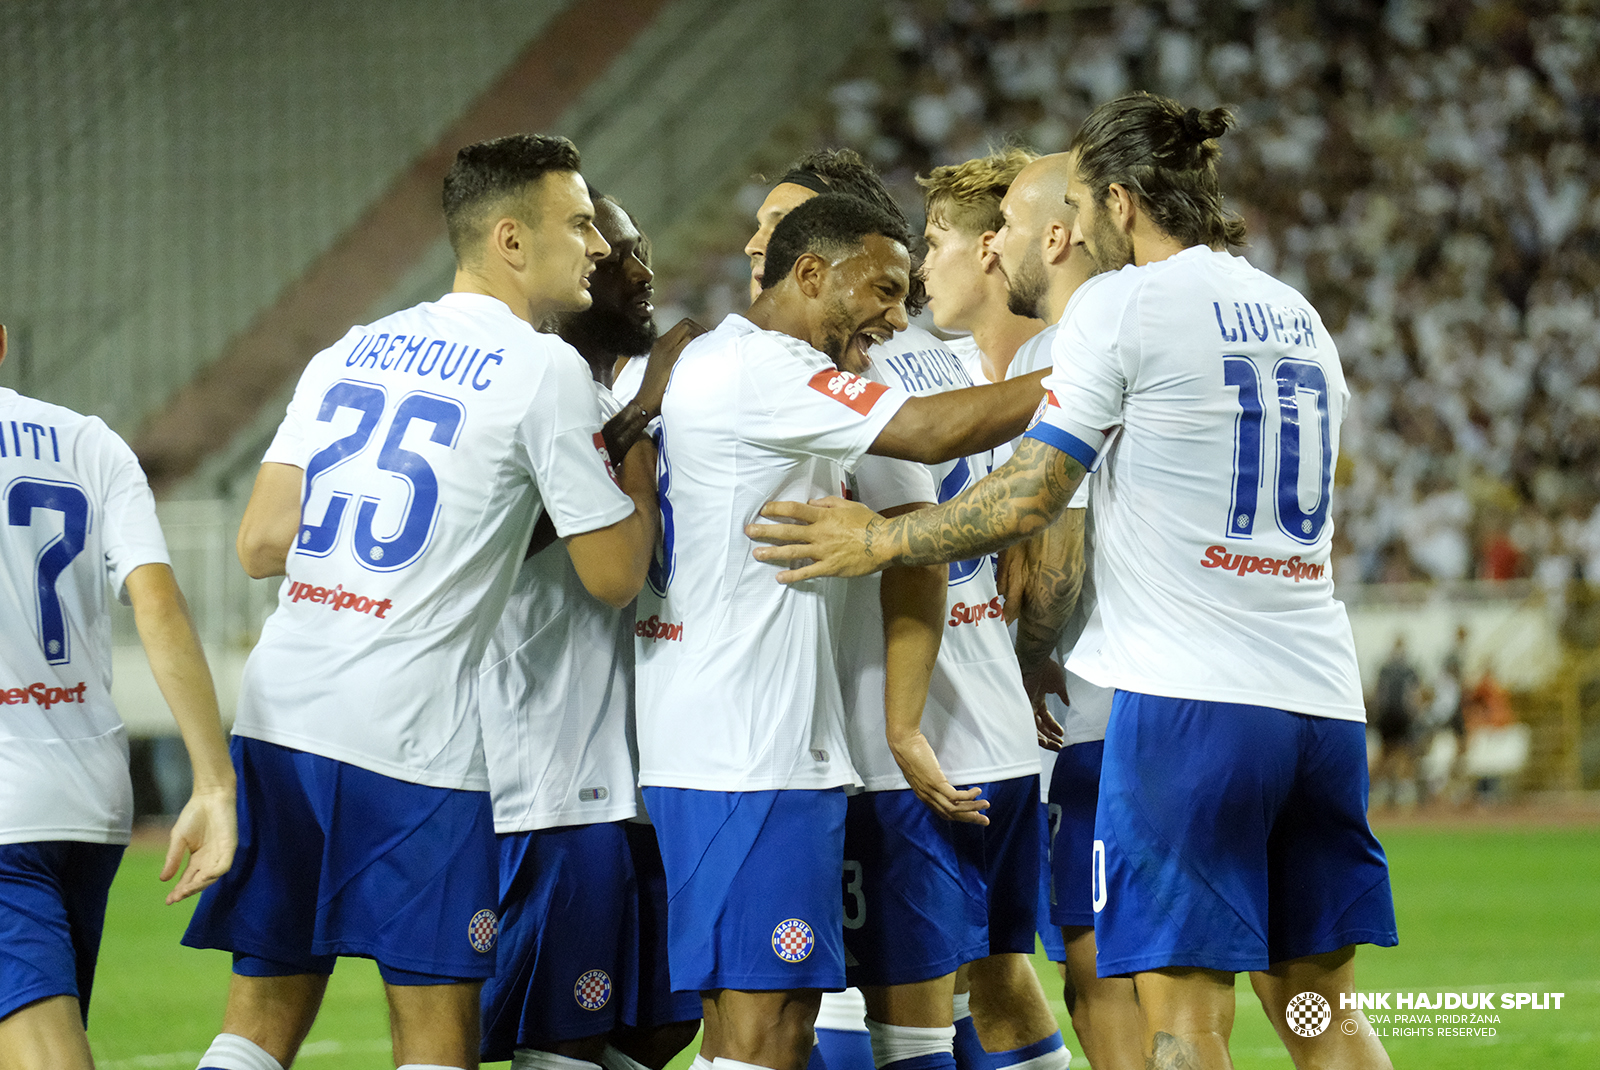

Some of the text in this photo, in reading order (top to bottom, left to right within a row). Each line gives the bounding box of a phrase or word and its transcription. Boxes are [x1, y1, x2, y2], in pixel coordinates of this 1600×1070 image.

[345, 333, 505, 391] UREMOVIĆ
[1220, 354, 1332, 546] 10
[294, 377, 467, 573] 25
[776, 920, 810, 935] HAJDUK
[780, 950, 806, 961] SPLIT
[578, 971, 607, 986] HAJDUK
[582, 997, 606, 1009] SPLIT
